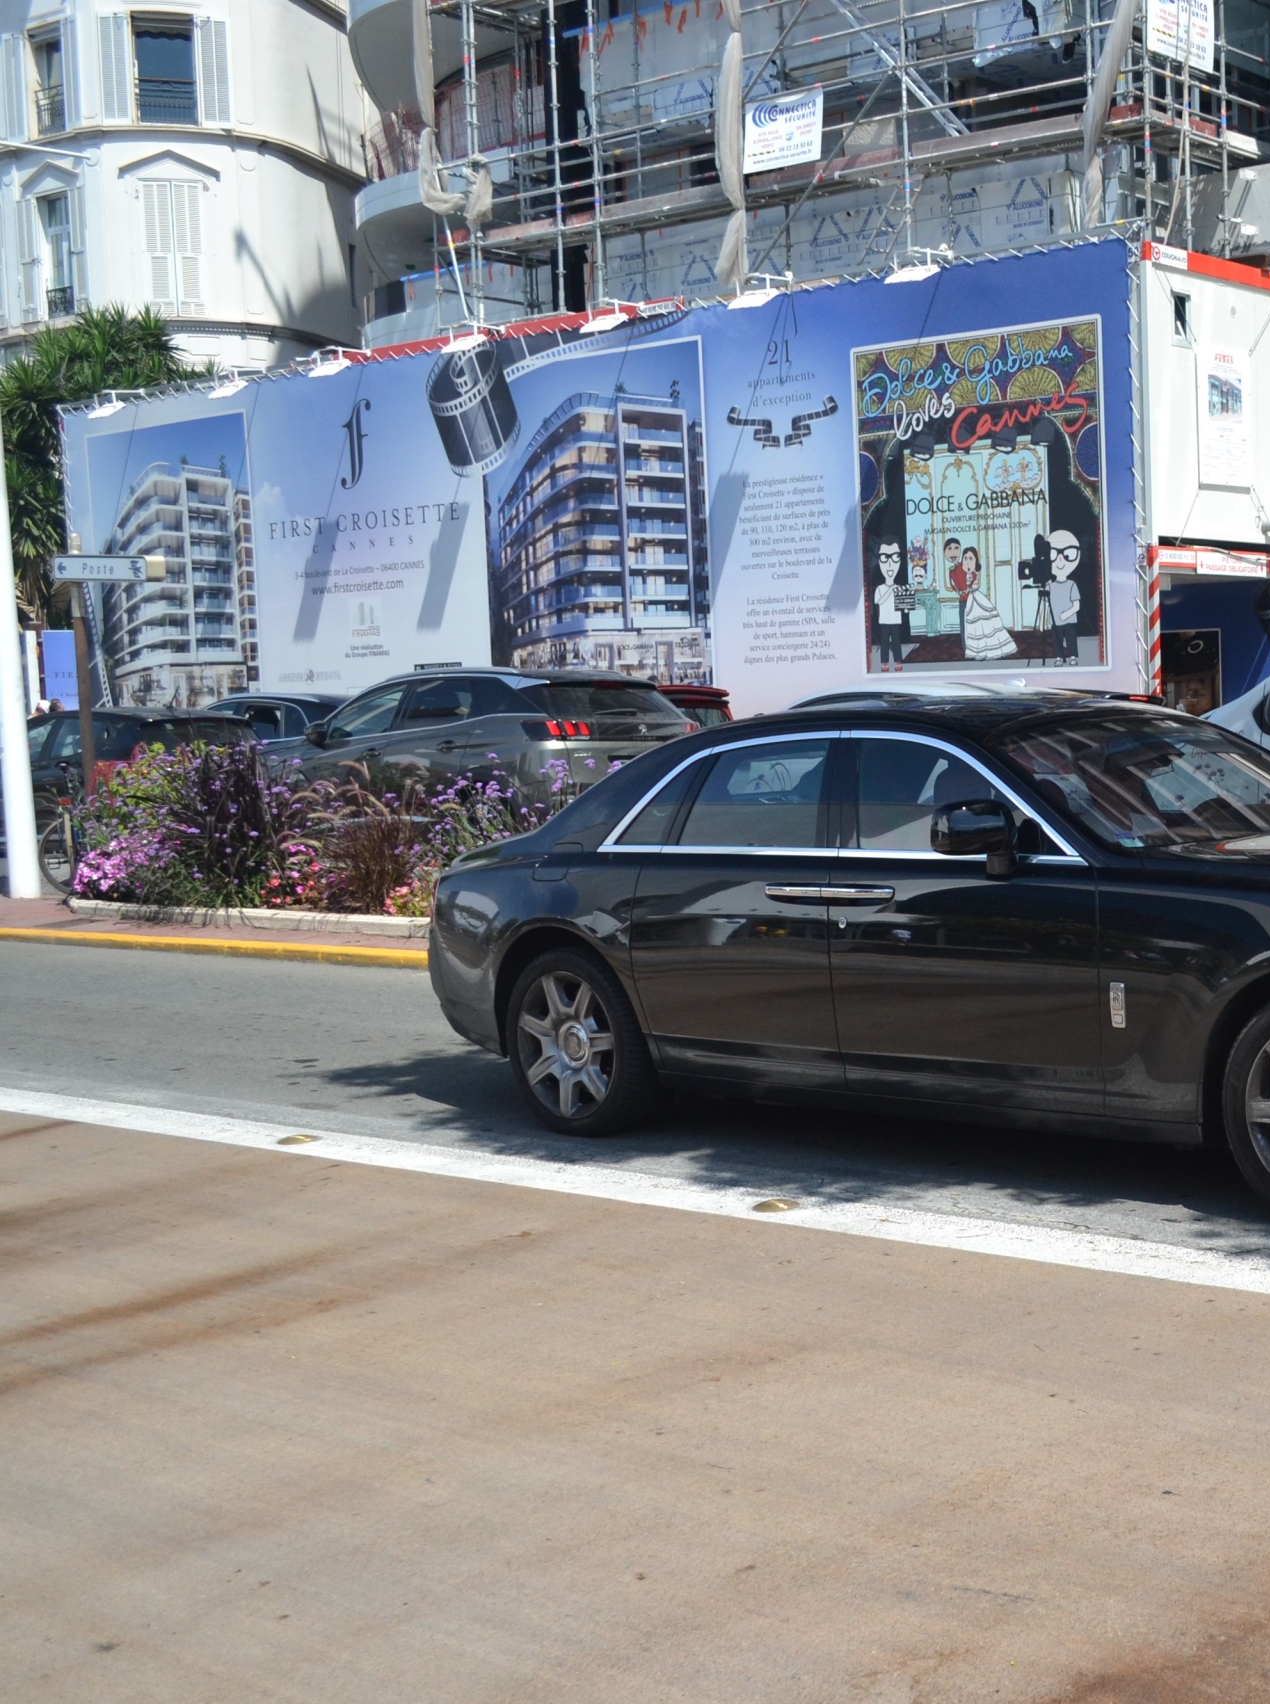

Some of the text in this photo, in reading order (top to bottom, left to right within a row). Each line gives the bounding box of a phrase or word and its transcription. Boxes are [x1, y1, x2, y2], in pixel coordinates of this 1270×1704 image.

[767, 339, 791, 366] 21
[747, 371, 816, 390] appartements
[862, 334, 1073, 418] Dolce & Gabbana
[752, 391, 812, 408] d'exception
[893, 392, 956, 440] loves
[907, 488, 1048, 516] DOLCE & GABBANA
[269, 501, 461, 541] FIRST CROISETTE
[942, 512, 1012, 524] OUVERTURE PROCHAINE
[924, 528, 952, 536] MAGASIN
[953, 526, 972, 534] DOLCE
[978, 524, 1008, 532] GABBANA
[312, 535, 415, 554] CANNES
[82, 563, 115, 575] Poste
[304, 569, 333, 579] boulevard
[349, 565, 375, 575] Croisette
[381, 562, 400, 572] 06400
[400, 560, 425, 570] CANNES
[1205, 563, 1259, 574] PASSAGE OBLIGATOIRE
[312, 580, 405, 596] www.firstcroisette.com
[55, 671, 78, 679] FIR
